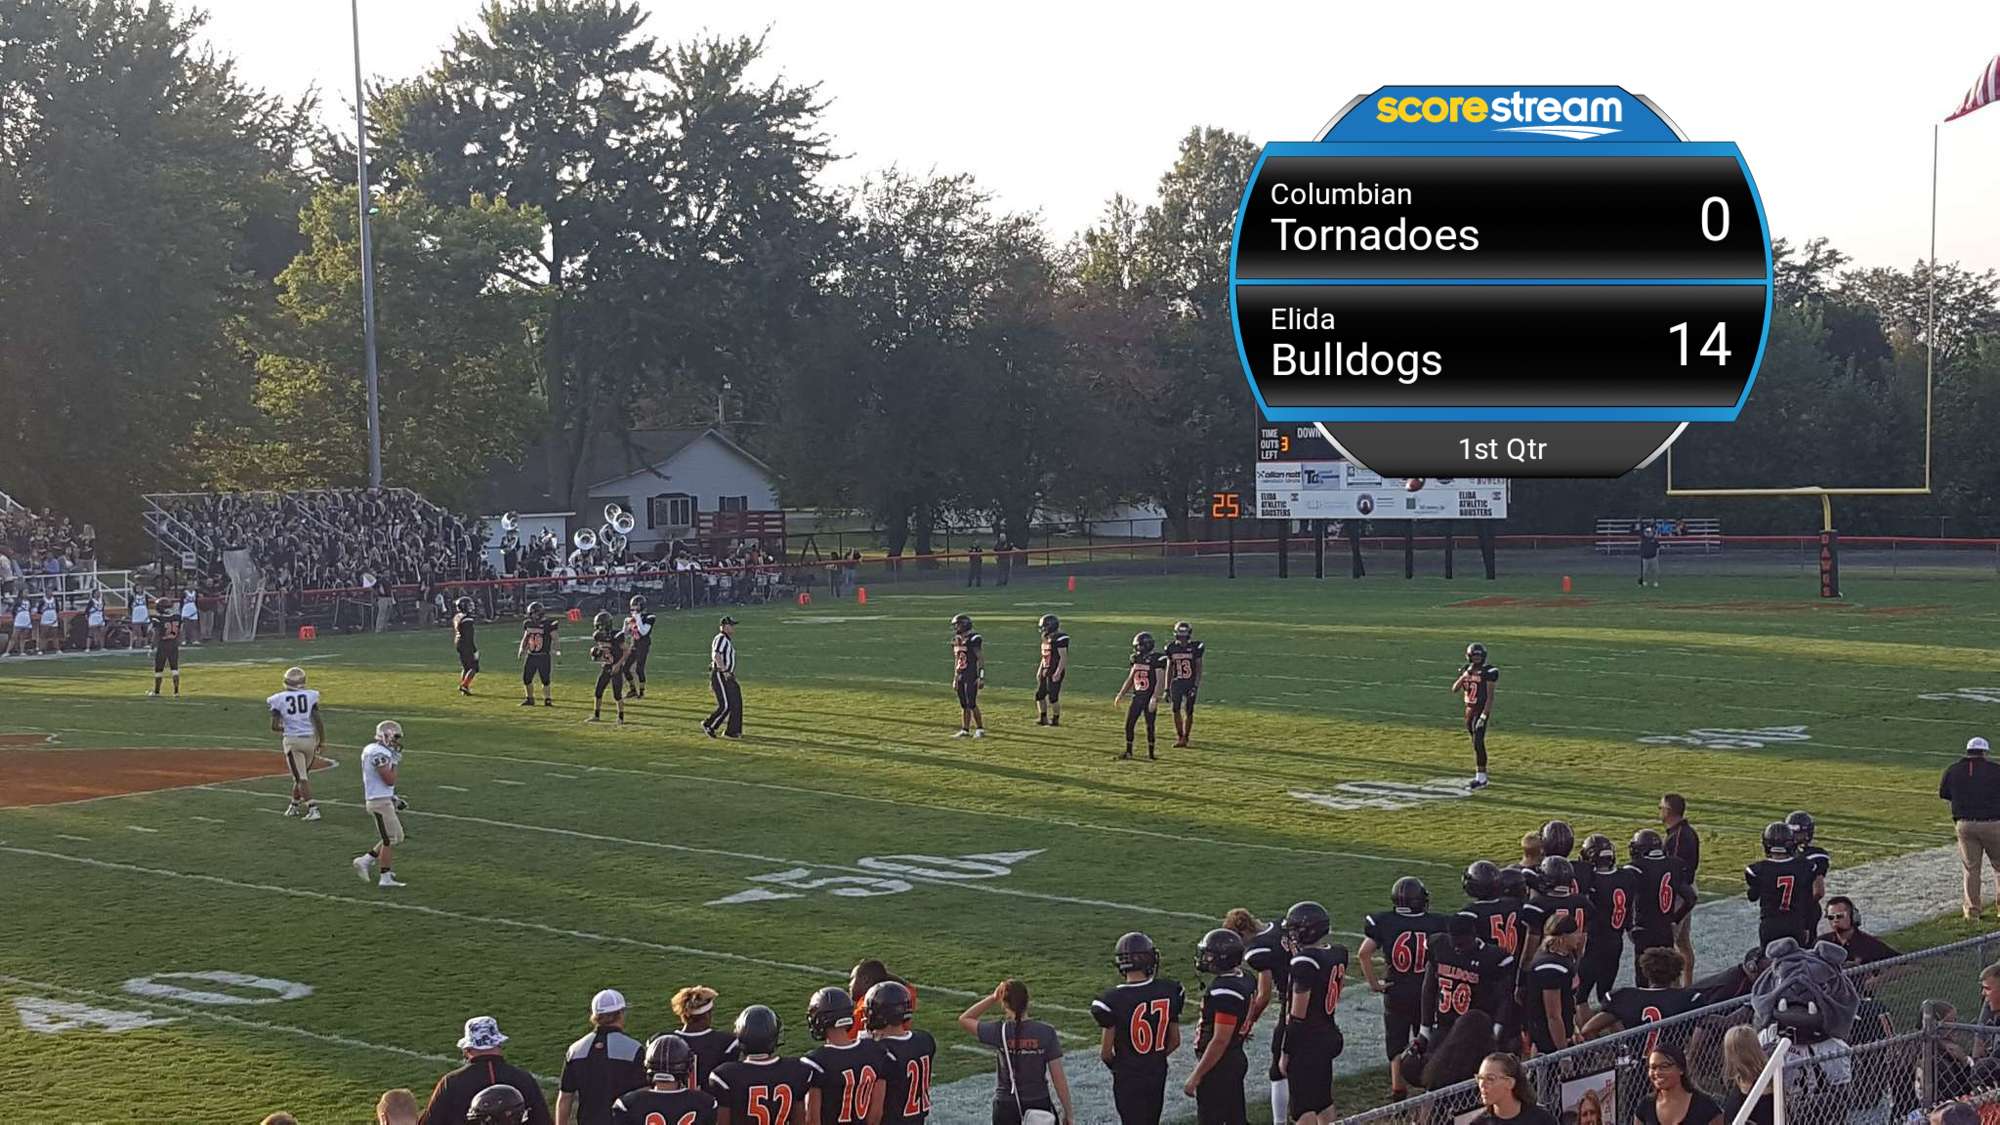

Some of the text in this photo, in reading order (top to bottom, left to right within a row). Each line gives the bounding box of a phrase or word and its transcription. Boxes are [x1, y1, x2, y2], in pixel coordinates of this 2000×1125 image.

[1260, 440, 1279, 449] OUTS
[1261, 428, 1278, 438] TIME
[1280, 436, 1289, 452] 3
[1261, 450, 1278, 460] LEFT
[1212, 494, 1239, 517] 25
[1175, 659, 1192, 679] 13
[285, 694, 309, 715] 30
[744, 853, 1012, 897] 50
[1659, 872, 1673, 913] 6
[1776, 876, 1795, 911] 7
[1612, 888, 1626, 929] 8
[1392, 931, 1426, 973] 61
[1490, 912, 1517, 955] 56
[1439, 977, 1471, 1015] 50
[1130, 998, 1170, 1054] 67
[747, 1083, 792, 1125] 52
[838, 1065, 877, 1122] 10
[903, 1055, 931, 1117] 21
